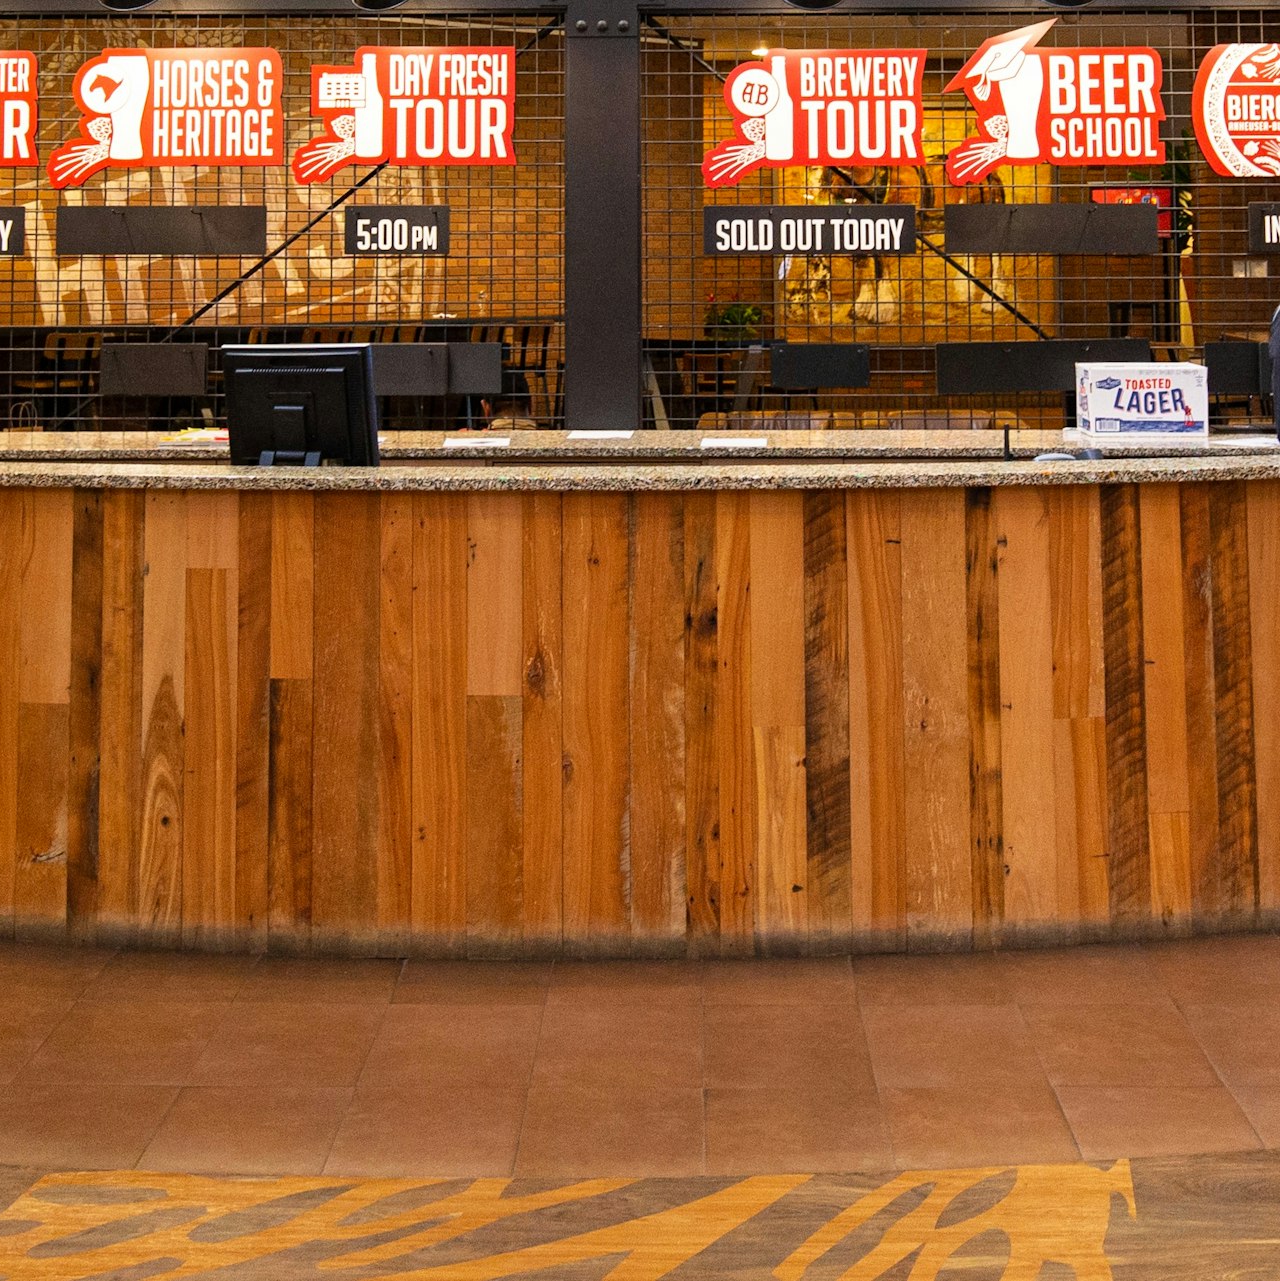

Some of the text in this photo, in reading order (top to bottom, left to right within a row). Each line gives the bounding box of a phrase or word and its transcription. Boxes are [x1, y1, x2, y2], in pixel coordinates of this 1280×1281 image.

[154, 59, 273, 108] HORSES &
[389, 54, 507, 96] DAY FRESH
[800, 57, 918, 97] BREWERY
[1049, 54, 1156, 114] BEER
[153, 109, 274, 157] HERITAGE
[389, 99, 507, 159] TOUR
[800, 100, 917, 159] TOUR
[1050, 117, 1157, 158] SCHOOL
[356, 219, 437, 251] 5:00 PM
[716, 219, 905, 251] SOLD OUT TODAY
[1114, 387, 1186, 415] LAGER
[1125, 378, 1171, 390] TOASTED
